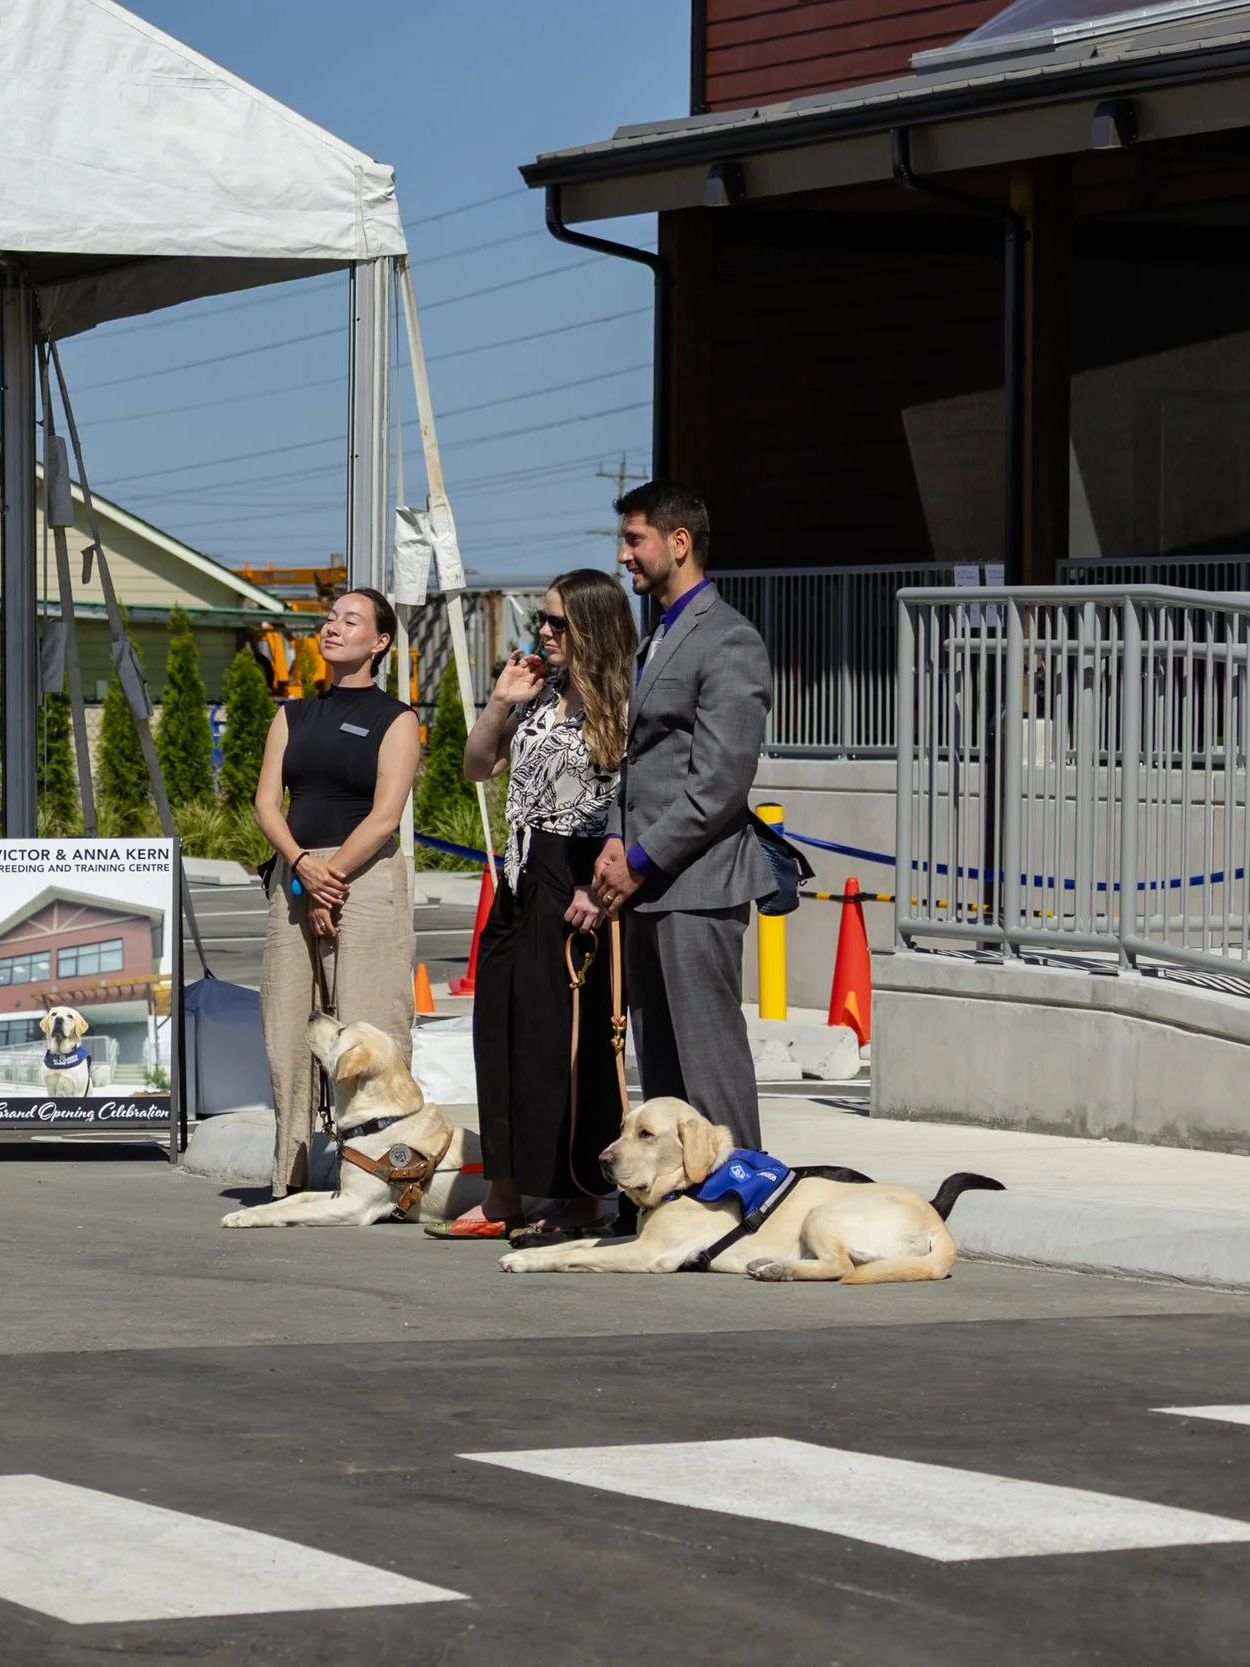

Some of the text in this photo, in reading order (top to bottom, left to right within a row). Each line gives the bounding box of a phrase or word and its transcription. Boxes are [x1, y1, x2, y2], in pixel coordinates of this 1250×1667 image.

[55, 848, 67, 861] &
[72, 848, 121, 861] ANNA
[126, 848, 170, 860] KERN
[47, 864, 72, 873] AND
[74, 863, 126, 873] TRAINING
[128, 863, 170, 872] CENTRE
[38, 1101, 95, 1122] Opening
[97, 1101, 170, 1120] Celebration
